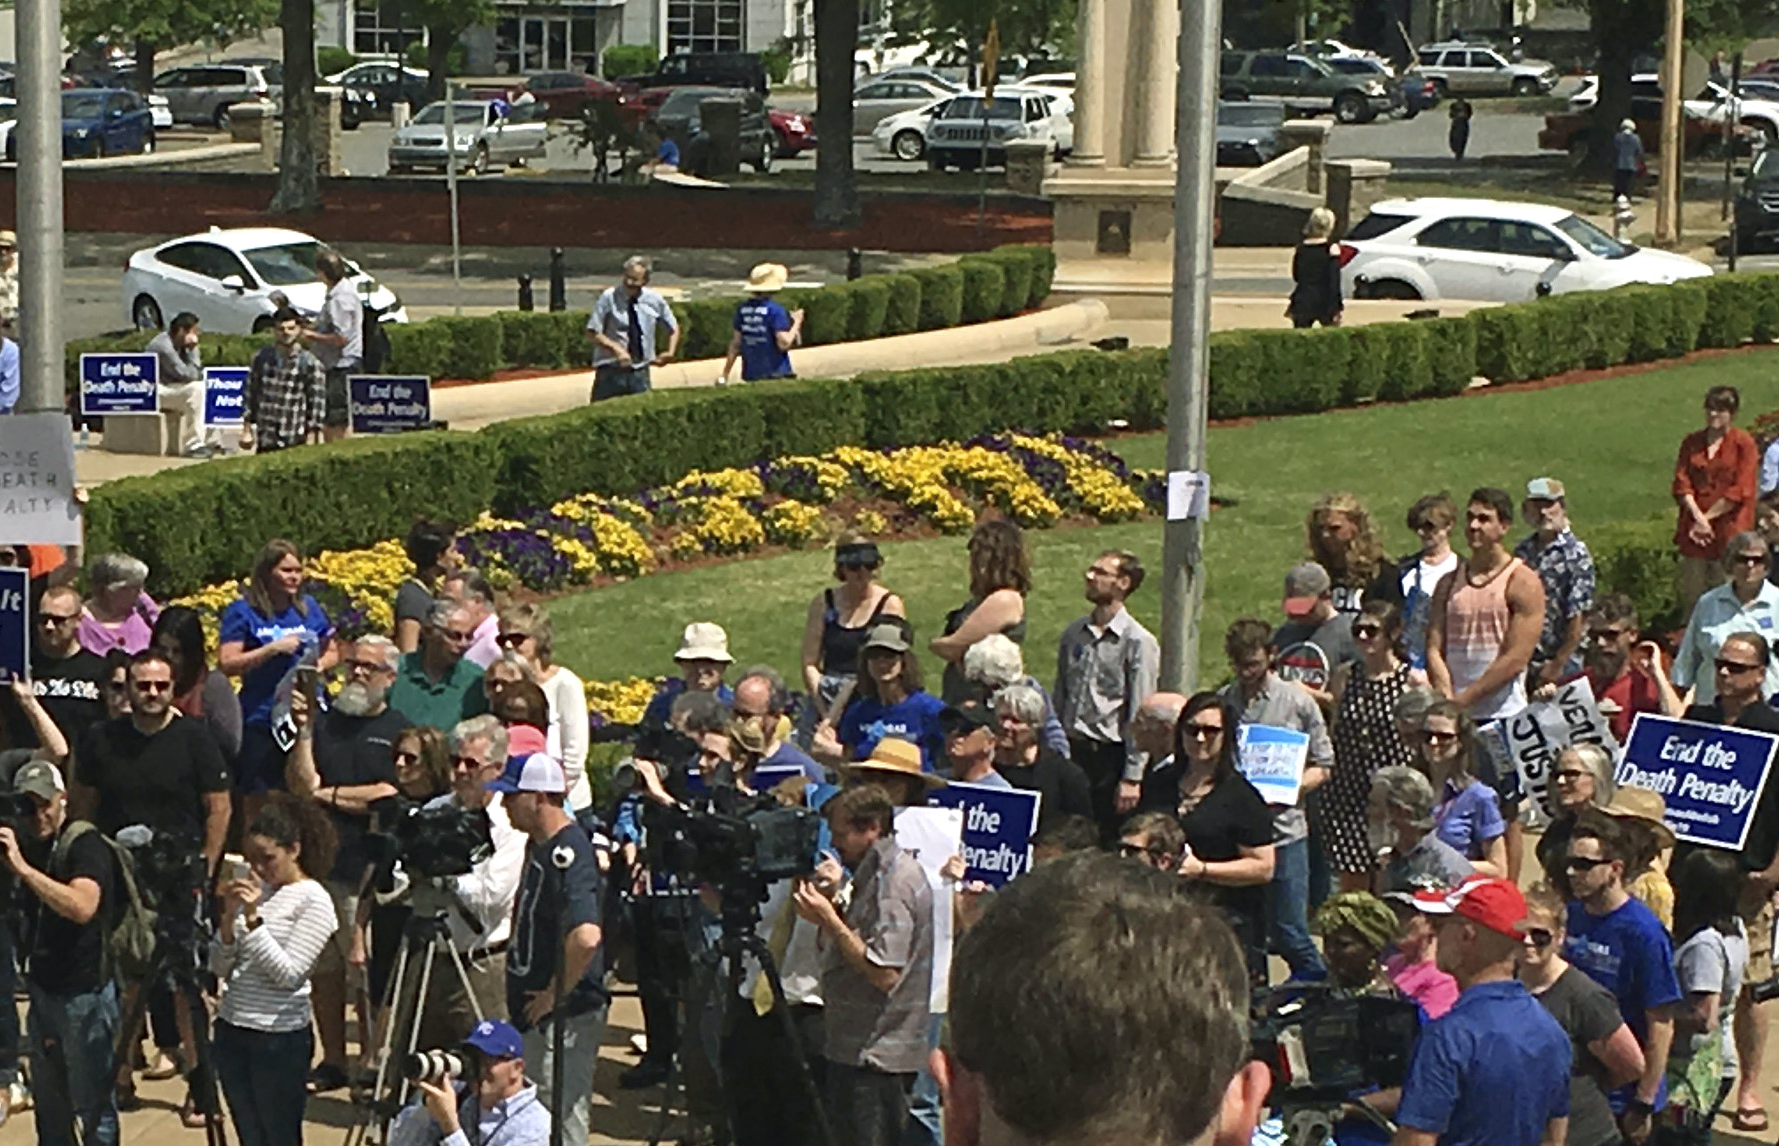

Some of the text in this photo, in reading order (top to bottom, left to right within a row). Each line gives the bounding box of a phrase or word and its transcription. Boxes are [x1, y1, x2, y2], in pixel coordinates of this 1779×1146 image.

[1660, 735, 1737, 770] End the
[1618, 762, 1755, 814] Death Penalty
[968, 803, 1001, 834] the
